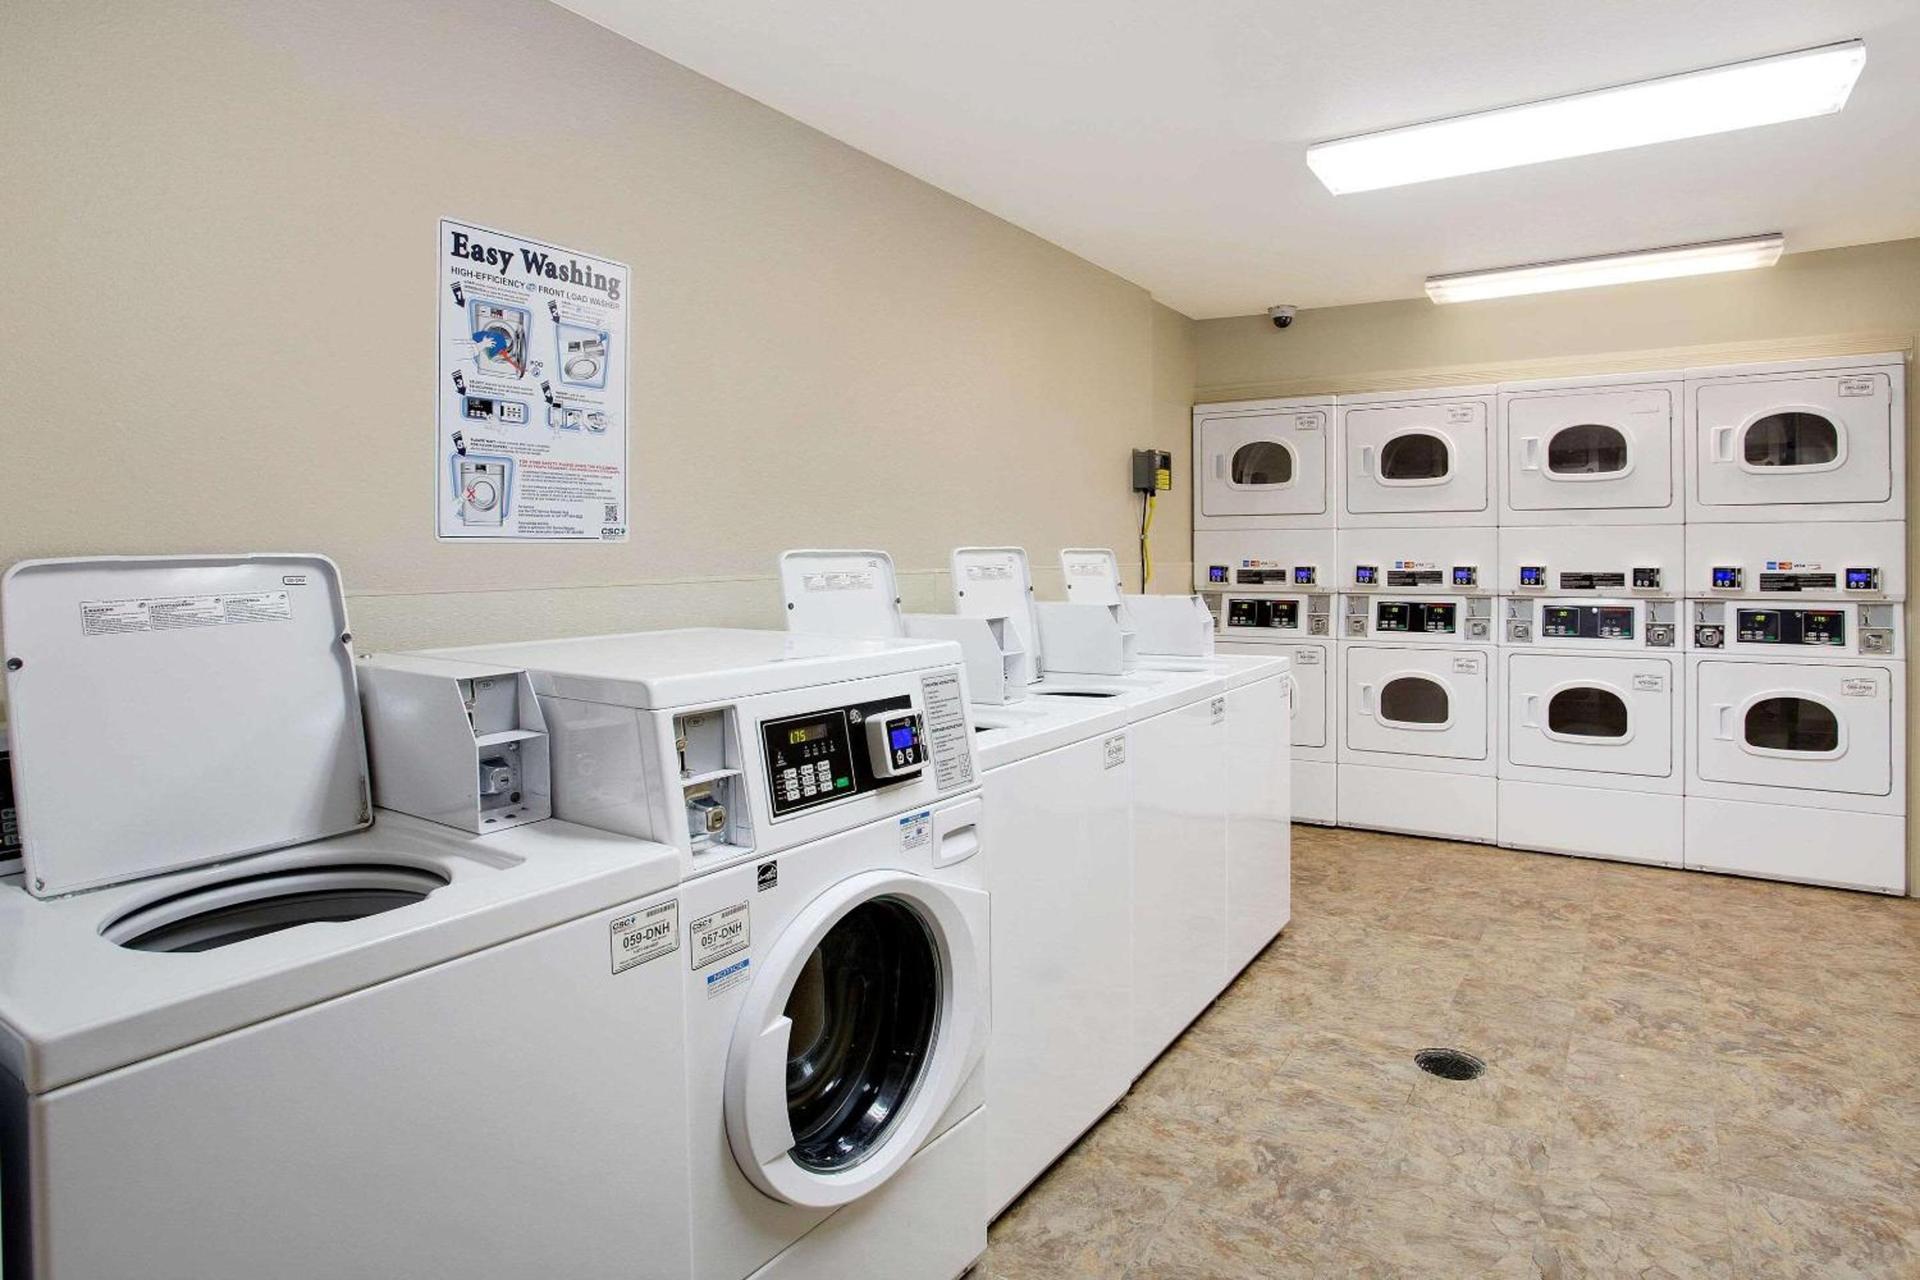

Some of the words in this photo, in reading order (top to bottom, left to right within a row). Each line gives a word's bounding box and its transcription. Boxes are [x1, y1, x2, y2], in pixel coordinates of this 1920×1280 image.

[451, 231, 514, 275] Easy
[519, 248, 621, 300] Washing
[451, 265, 525, 289] HIGH-EFFICIENCY
[538, 285, 565, 298] FRONT
[566, 292, 589, 303] LOAD
[589, 297, 620, 310] WASHER
[623, 921, 670, 949] 059-DNH
[701, 921, 742, 947] 057-DNH
